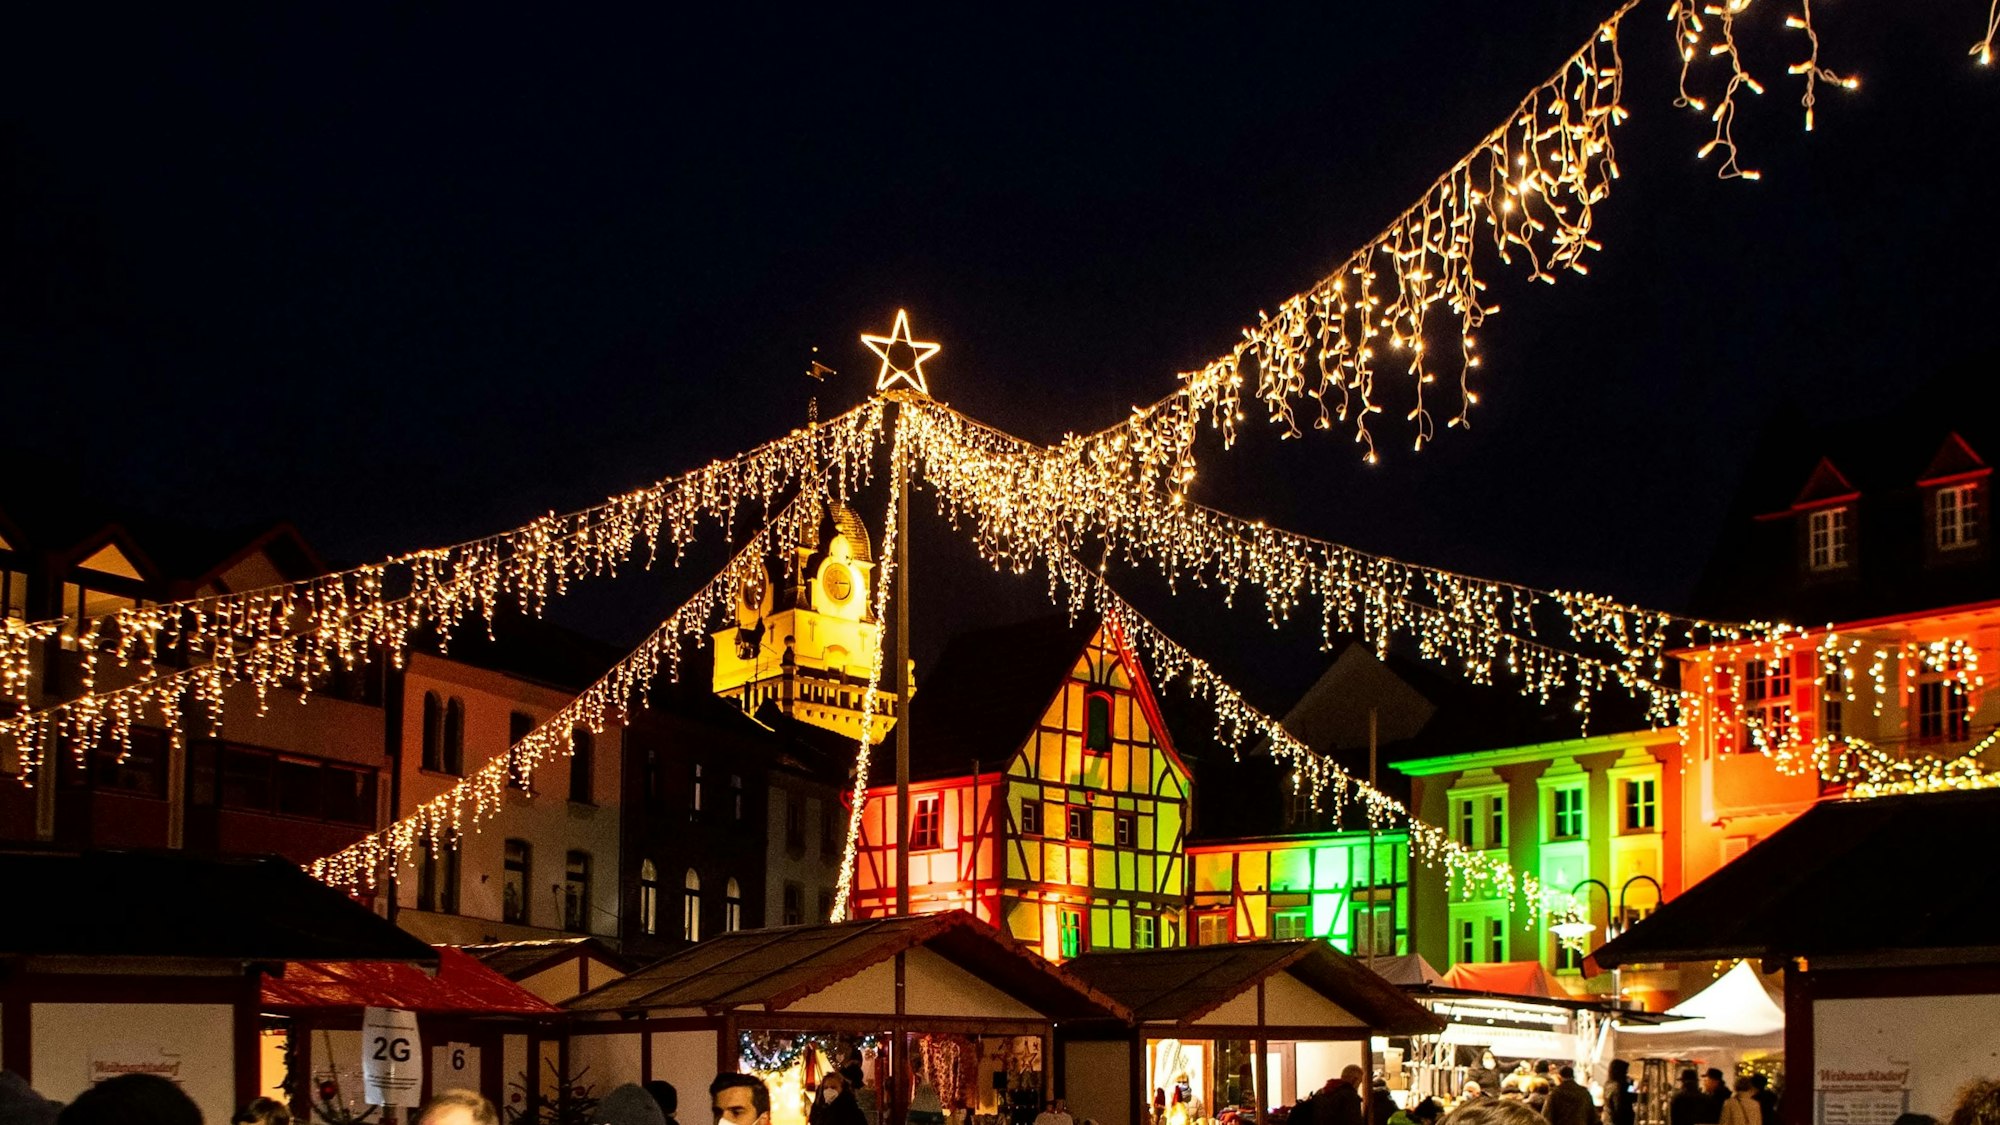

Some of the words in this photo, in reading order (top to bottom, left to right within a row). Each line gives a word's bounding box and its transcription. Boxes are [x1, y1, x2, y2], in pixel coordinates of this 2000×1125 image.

[372, 1036, 411, 1062] 2G
[452, 1049, 465, 1071] 6
[1819, 1069, 1910, 1085] Weihnachtsdorf
